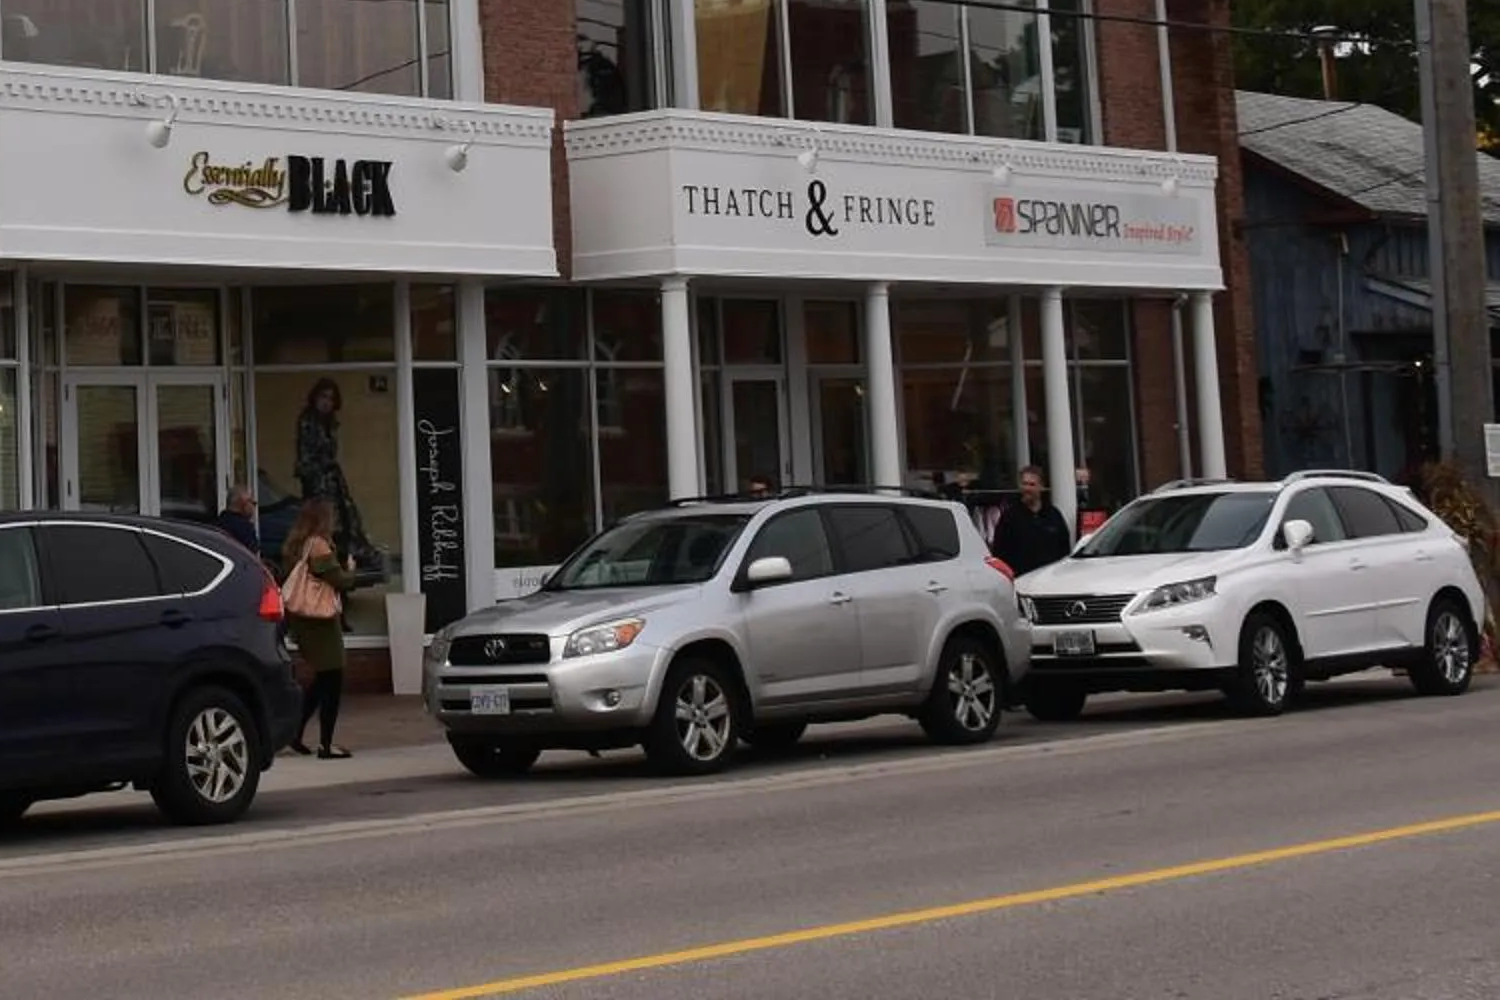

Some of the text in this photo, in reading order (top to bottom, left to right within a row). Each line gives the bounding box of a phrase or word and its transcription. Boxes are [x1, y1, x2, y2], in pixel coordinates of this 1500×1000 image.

[183, 151, 396, 216] Essentially BLACK
[682, 179, 936, 237] THATCH & FRINGE
[417, 419, 456, 494] Joseph
